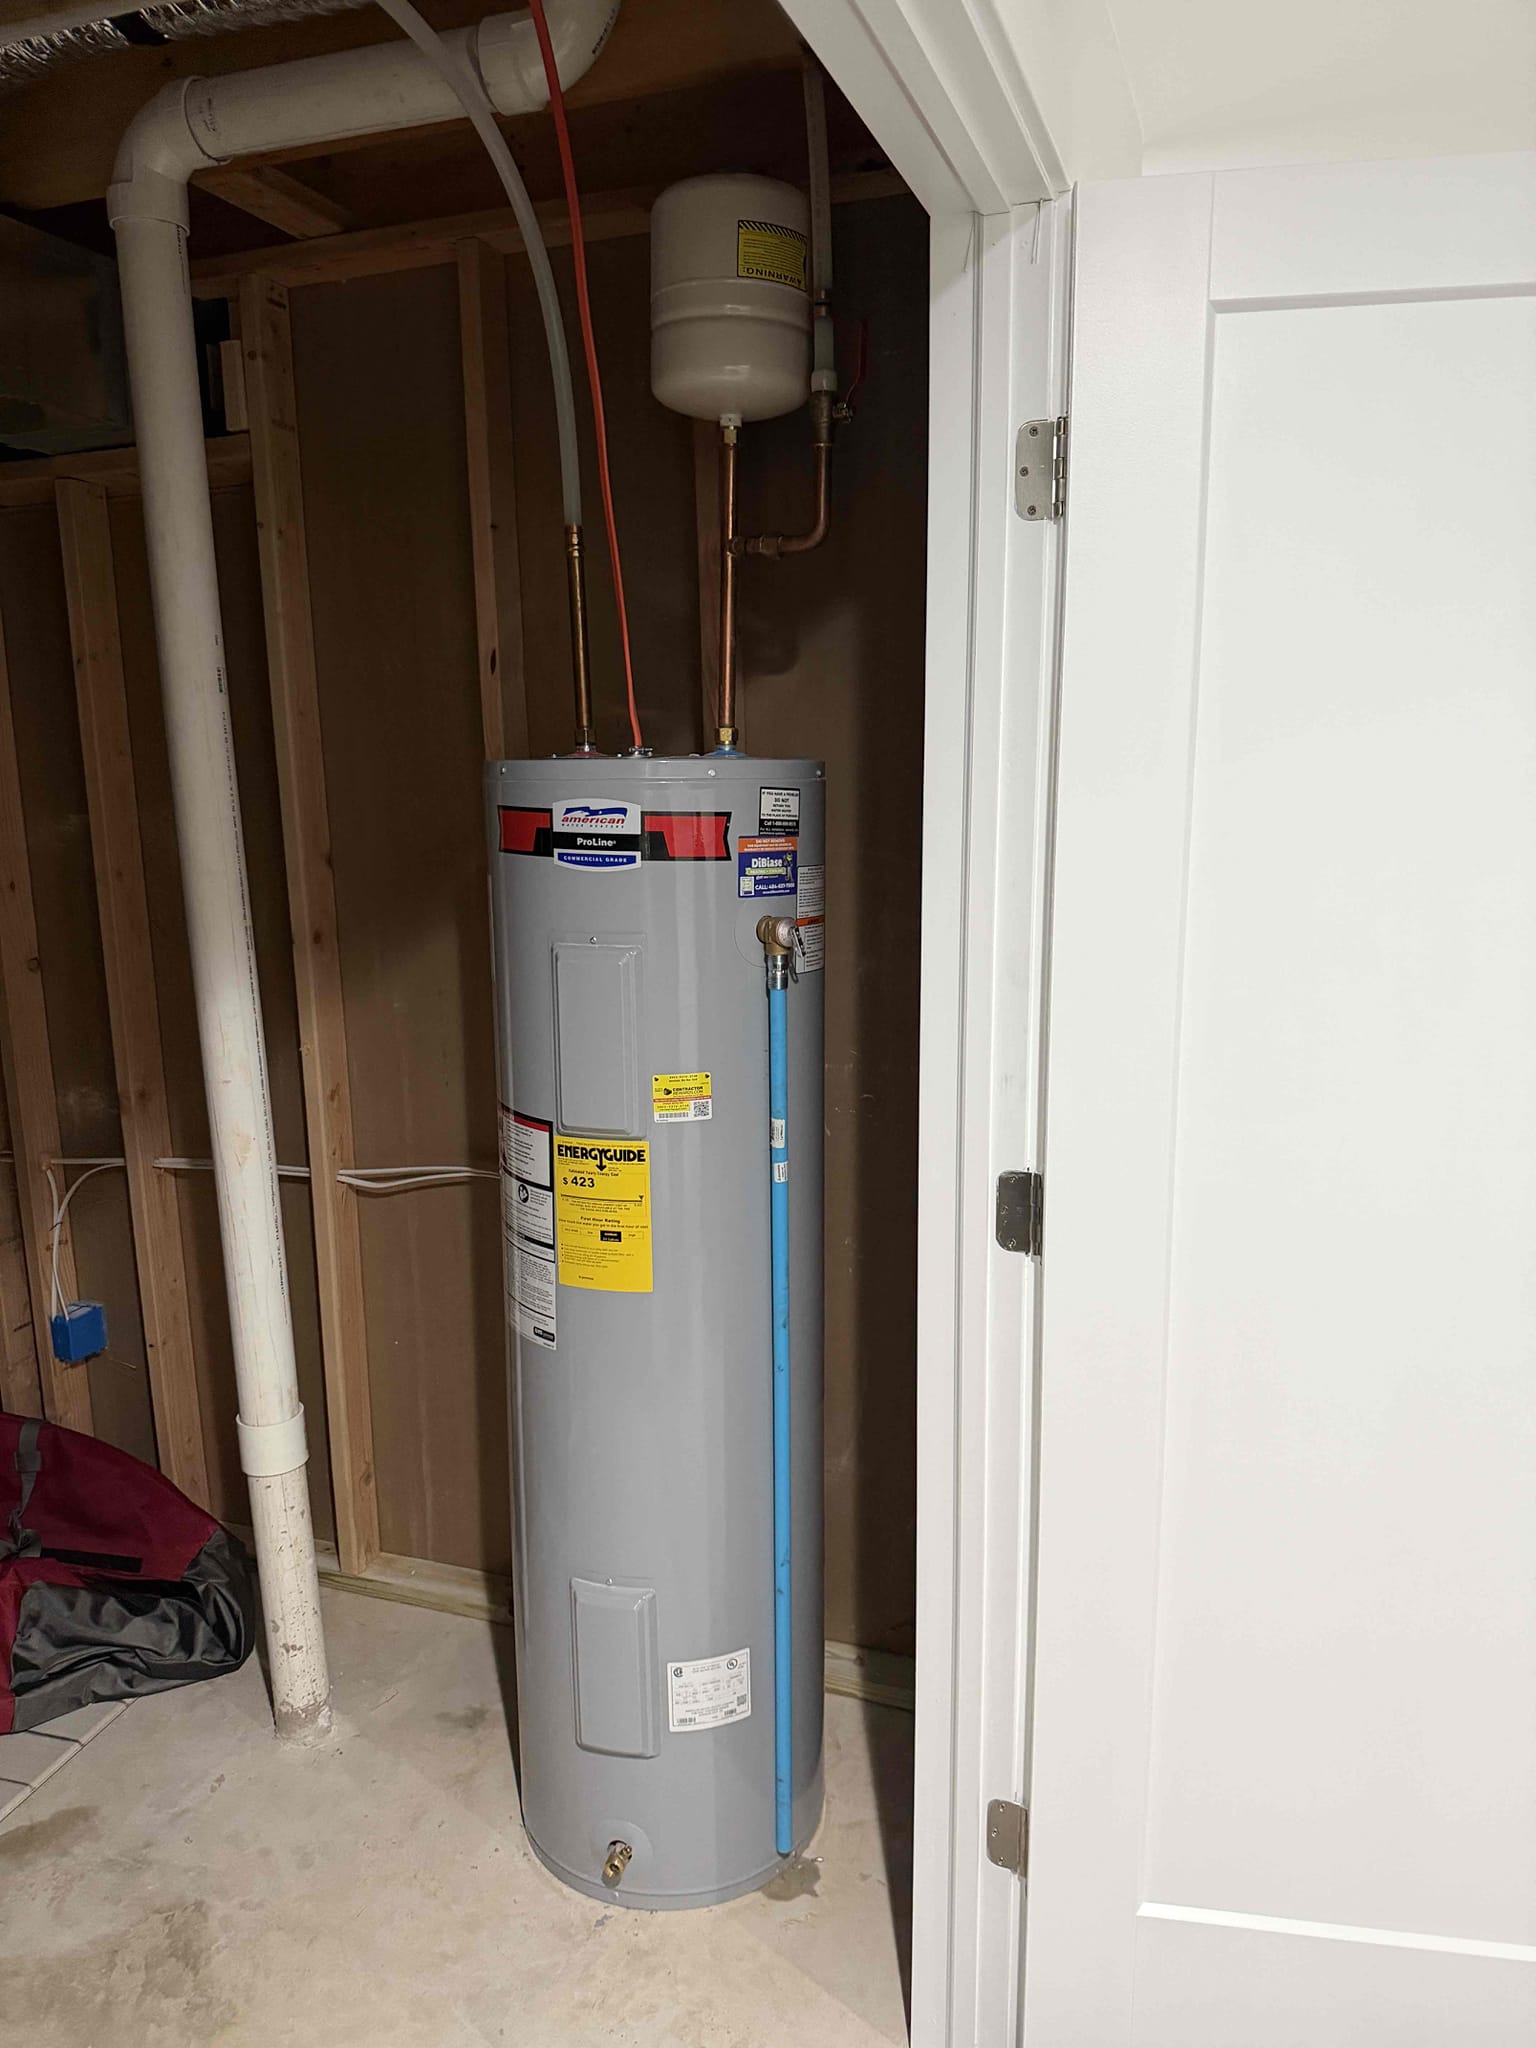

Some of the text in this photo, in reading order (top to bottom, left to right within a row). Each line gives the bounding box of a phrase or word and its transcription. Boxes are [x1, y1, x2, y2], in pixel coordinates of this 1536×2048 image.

[561, 816, 625, 825] american
[563, 855, 603, 863] COMMERCIAL
[751, 857, 783, 868] DiBiase
[557, 1144, 646, 1164] ENERGYGUIDE
[571, 1176, 595, 1188] 423
